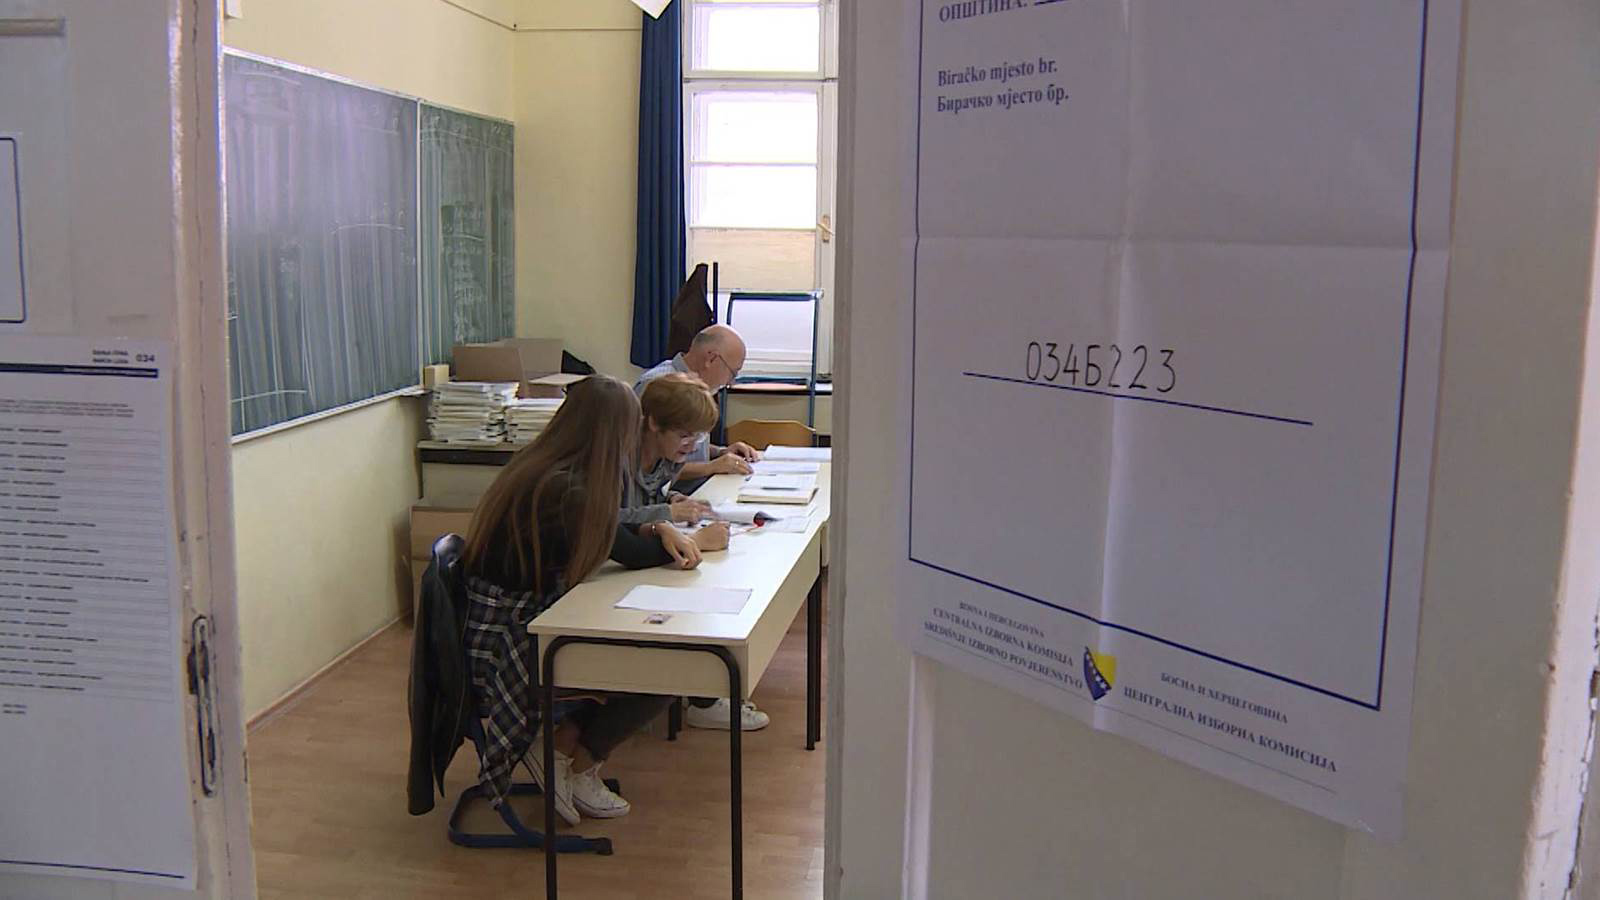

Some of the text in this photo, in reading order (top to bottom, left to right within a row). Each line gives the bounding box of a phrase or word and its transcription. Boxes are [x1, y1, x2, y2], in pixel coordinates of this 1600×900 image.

[938, 57, 1058, 87] Biračko mjesto br.
[937, 83, 1069, 114] Бирачко мјесто бр.
[135, 353, 156, 363] 034
[923, 620, 1083, 690] SREDIŠNJE IZBORNO POVJERENSTVO
[932, 607, 1074, 667] CENTRALNA IZBORNA KOMISIJA
[1160, 672, 1289, 724] БОСНА И ХЕРЦЕГОВИНА
[1123, 686, 1338, 772] ЦЕНТРАЛНА ИЗБОРНА КОМИСИЈА
